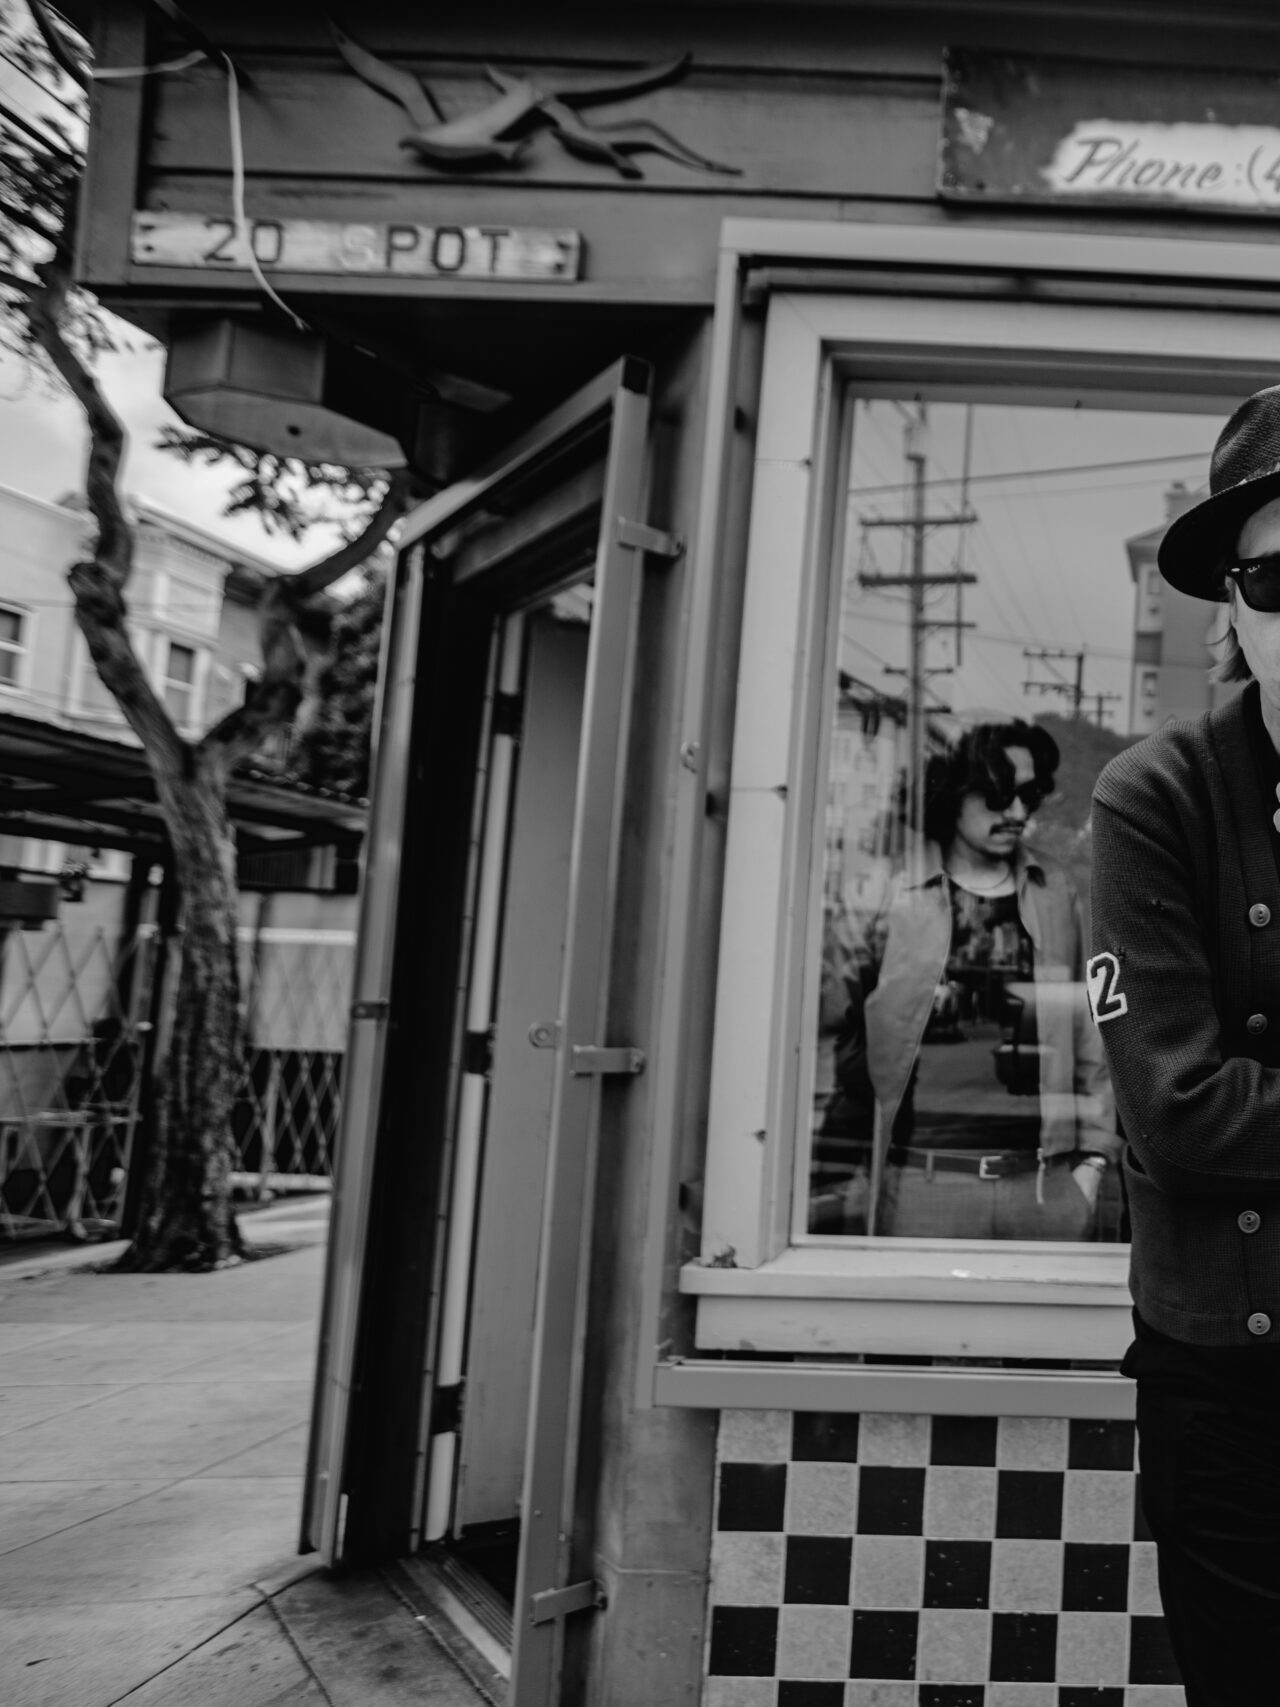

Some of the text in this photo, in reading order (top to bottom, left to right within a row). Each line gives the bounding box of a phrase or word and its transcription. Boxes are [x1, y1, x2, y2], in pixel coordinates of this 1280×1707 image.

[203, 217, 510, 274] 20 SPOT
[1087, 951, 1128, 1024] 2
